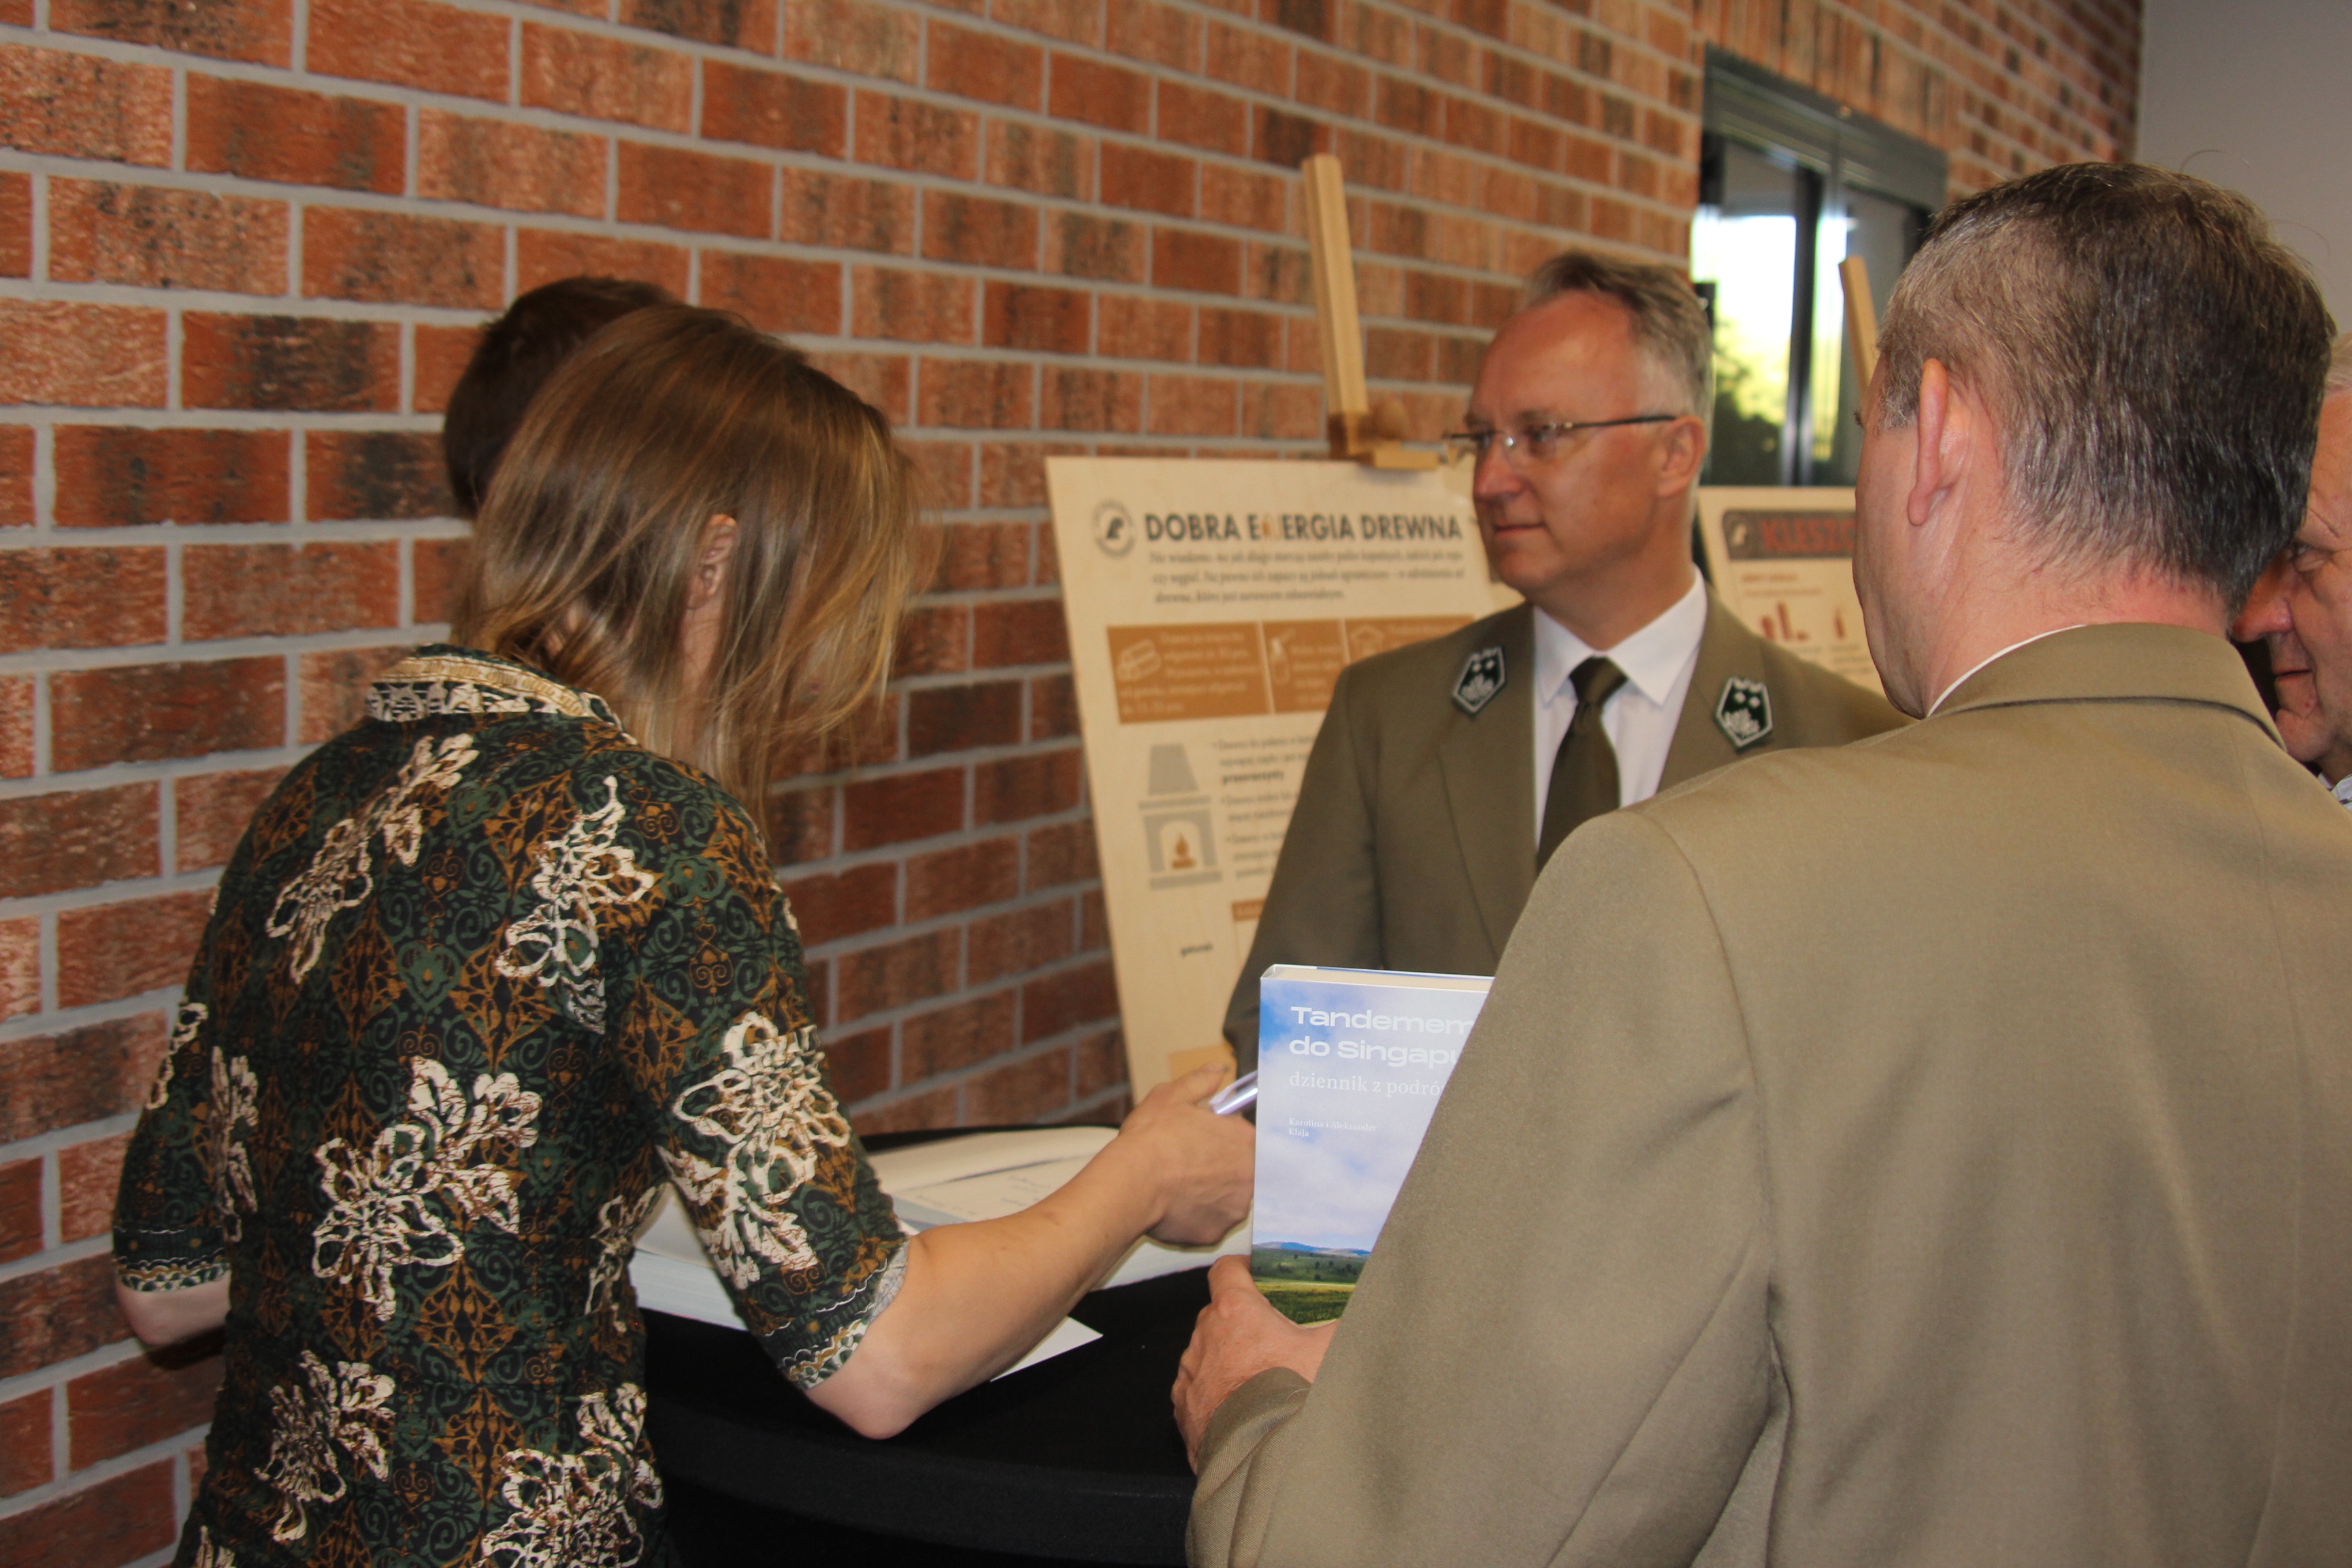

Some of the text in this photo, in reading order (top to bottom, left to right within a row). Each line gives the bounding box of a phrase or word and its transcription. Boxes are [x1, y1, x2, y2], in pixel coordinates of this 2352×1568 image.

[1145, 513, 1241, 542] DOBRA
[1360, 514, 1463, 542] DREWNA
[1290, 1036, 1330, 1057] do
[1290, 1071, 1446, 1097] dziennik z podró
[1289, 1117, 1324, 1128] Karolina
[1330, 1120, 1377, 1132] Aleksander
